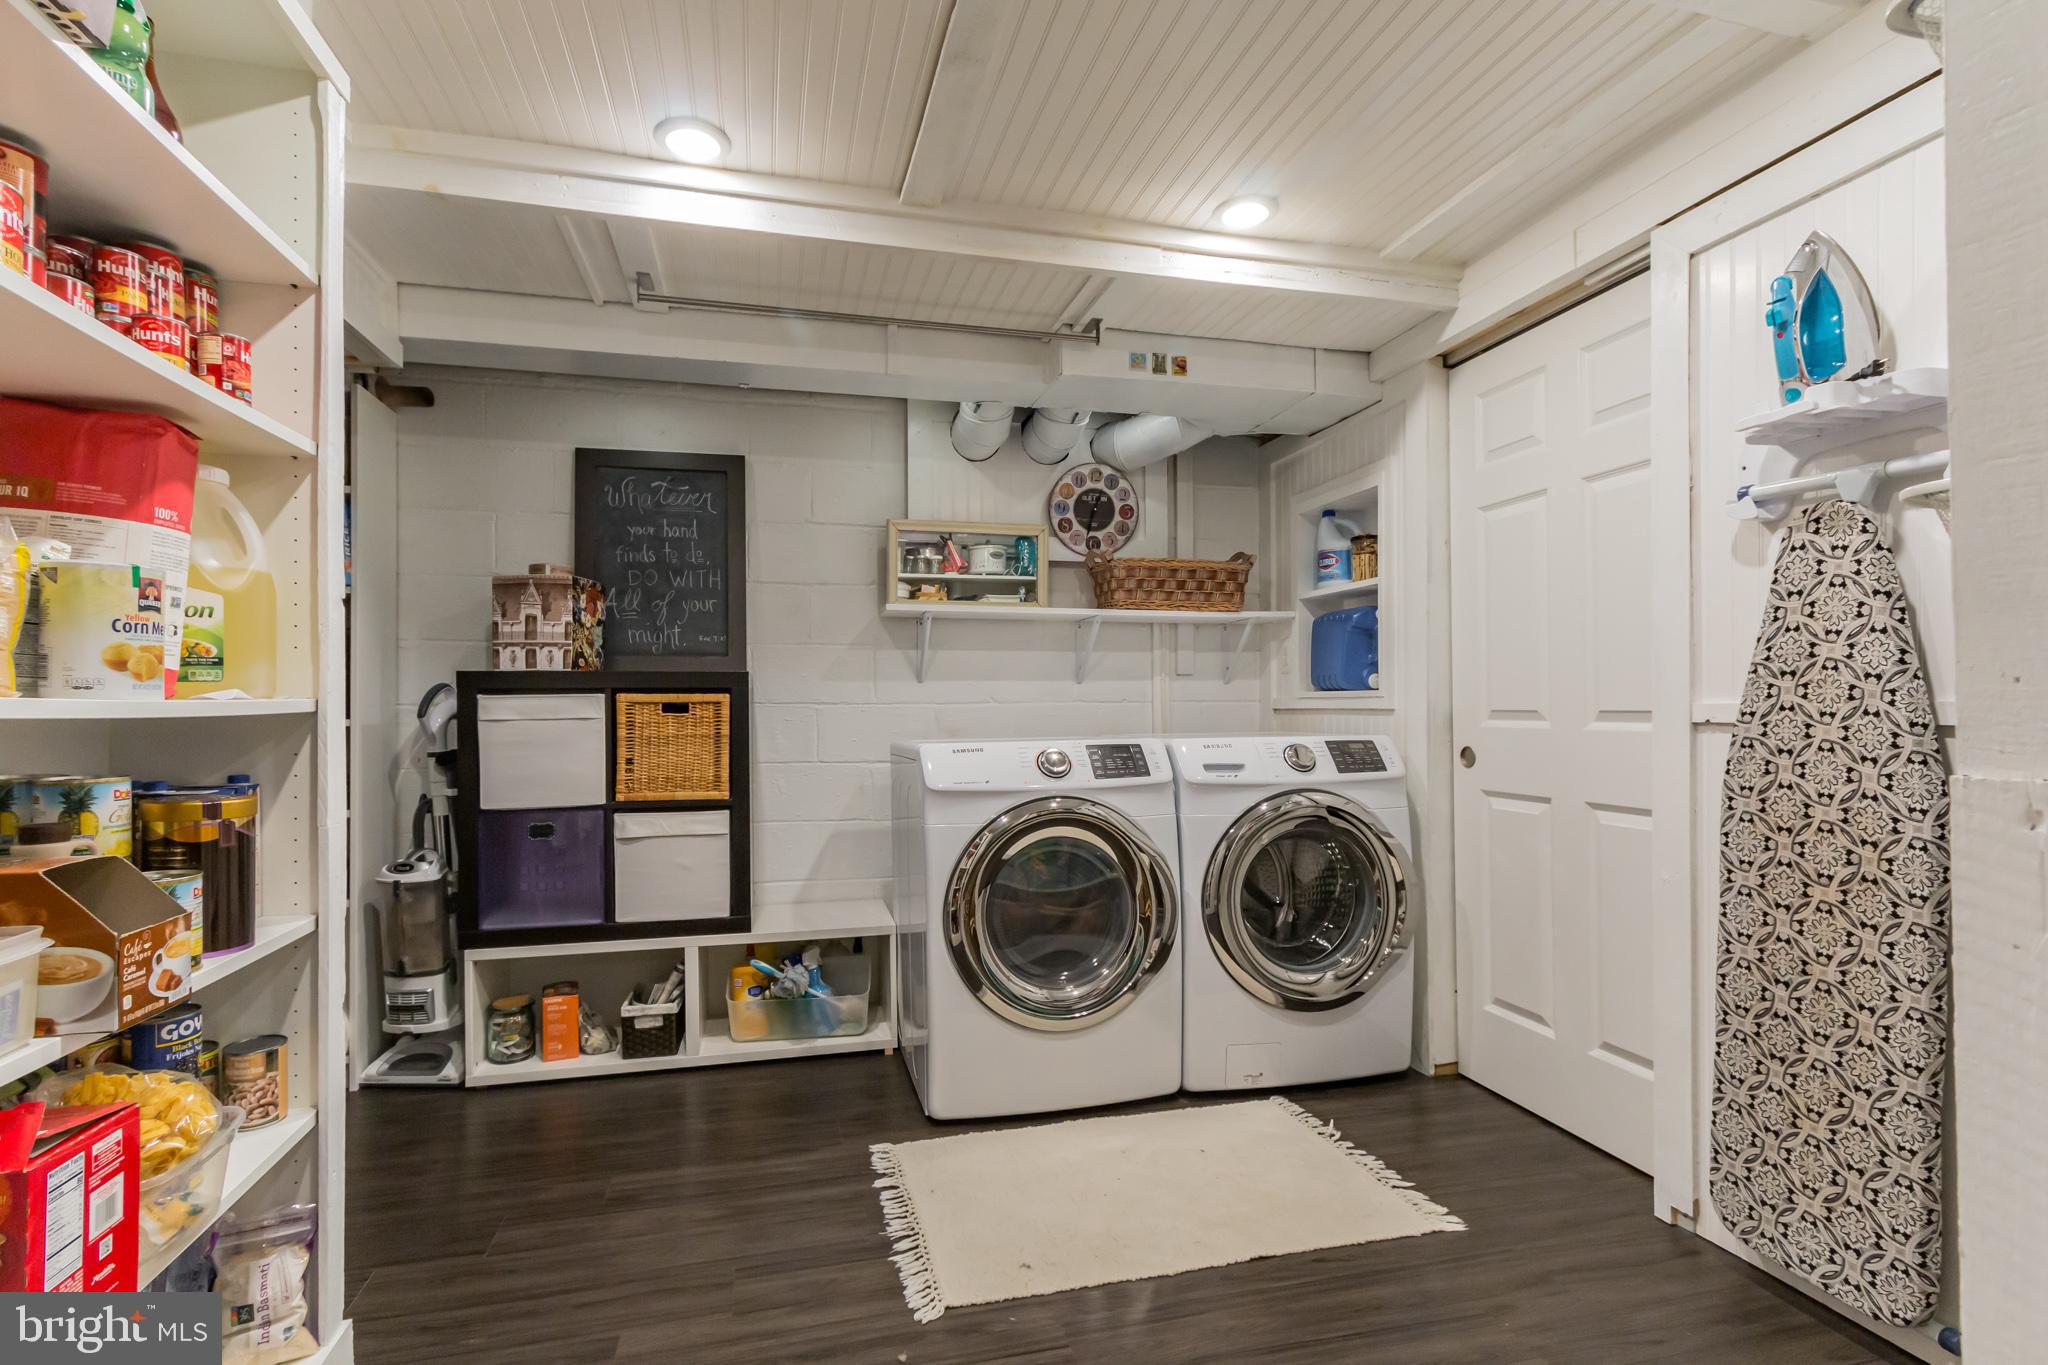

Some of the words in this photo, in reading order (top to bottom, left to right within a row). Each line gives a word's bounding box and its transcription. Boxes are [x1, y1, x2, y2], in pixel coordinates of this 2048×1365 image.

[154, 507, 179, 522] 100%
[627, 524, 656, 540] your
[663, 518, 698, 540] hand
[615, 544, 656, 564] finds
[664, 541, 678, 563] to
[628, 569, 658, 587] DO
[669, 569, 722, 590] WITH
[124, 613, 151, 622] Yellow
[652, 590, 675, 626] of
[677, 598, 718, 625] your
[112, 618, 149, 635] Corn
[257, 1262, 271, 1314] Basmati
